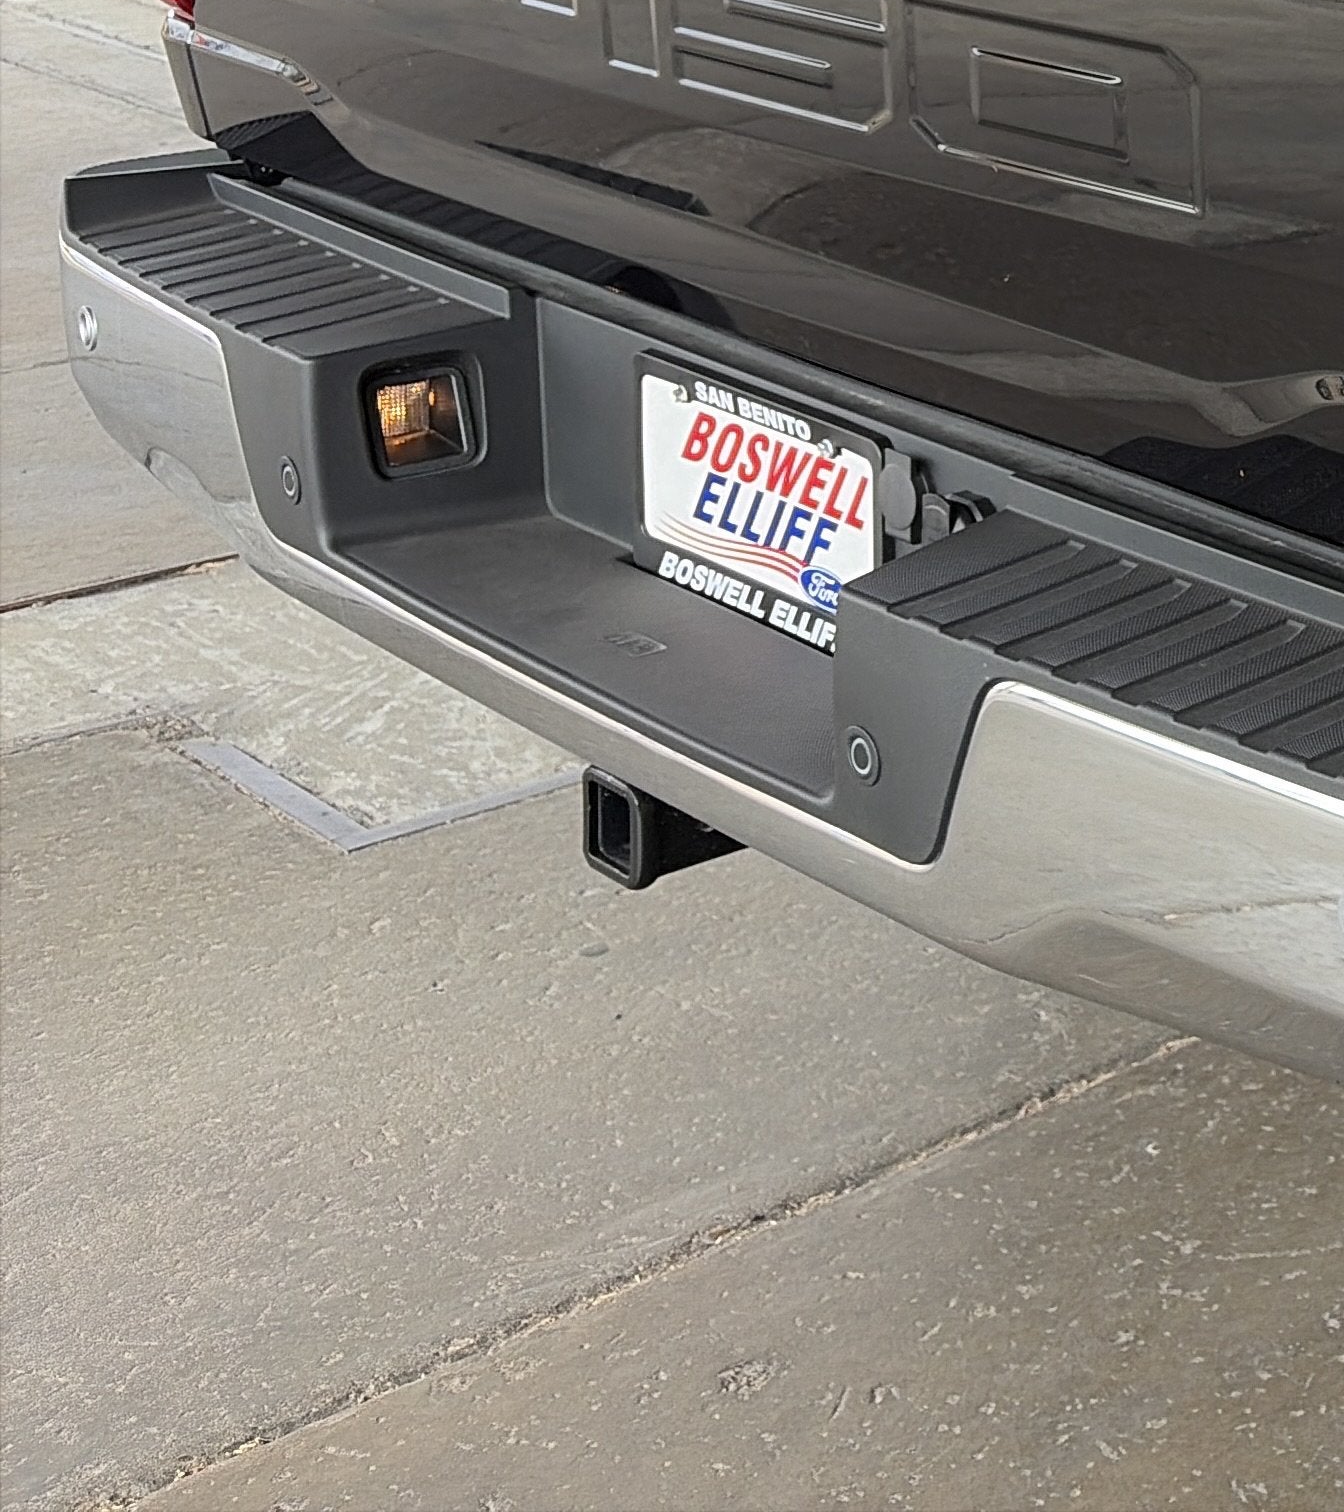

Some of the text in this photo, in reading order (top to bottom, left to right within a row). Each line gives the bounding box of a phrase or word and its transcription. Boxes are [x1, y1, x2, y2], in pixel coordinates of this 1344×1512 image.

[694, 381, 812, 441] SAN BENITO
[680, 411, 869, 530] BOSWELL
[692, 472, 840, 564] ELLIFF
[658, 550, 767, 619] BOSWELL
